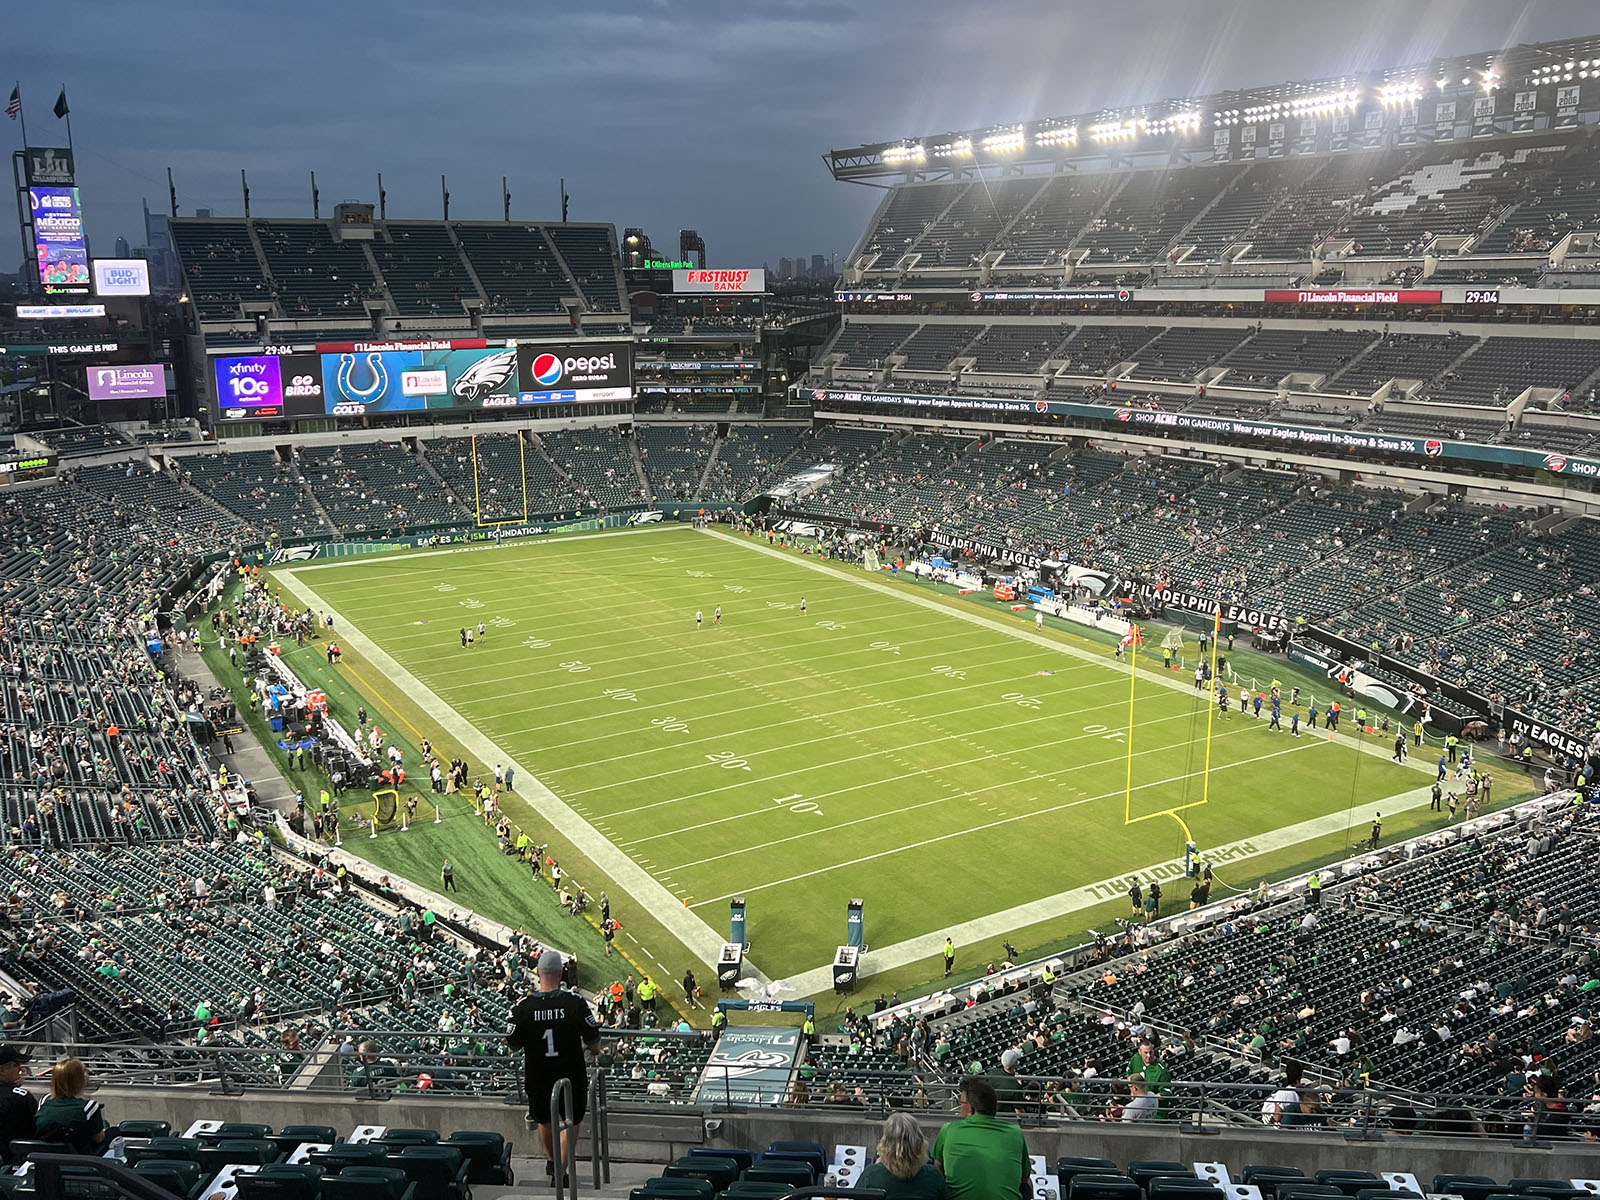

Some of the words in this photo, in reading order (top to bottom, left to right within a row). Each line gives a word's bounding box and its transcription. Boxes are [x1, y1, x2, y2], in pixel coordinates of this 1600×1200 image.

[107, 277, 138, 285] LIGHT
[1307, 292, 1338, 302] Lincoln
[1338, 292, 1375, 302] Financial
[1376, 292, 1398, 302] Field
[1466, 291, 1498, 303] 29:04
[48, 345, 69, 353] THIS
[70, 345, 94, 353] GAME
[94, 344, 102, 352] IS
[264, 345, 293, 355] 29:04
[363, 343, 394, 352] Lincoln
[395, 341, 430, 351] Financial
[431, 340, 451, 350] Field
[229, 362, 267, 376] xfinity
[564, 352, 614, 375] pepsi
[116, 368, 153, 379] Lincoln
[291, 375, 313, 385] GO
[229, 376, 269, 396] 10G
[285, 384, 321, 396] BIRDS
[482, 397, 517, 407] EAGLES
[829, 392, 844, 400] SHOP
[844, 392, 862, 401] ACME
[872, 395, 902, 404] GAMEDAYS
[903, 397, 918, 405] Wear
[932, 399, 950, 407] Eagles
[951, 400, 973, 408] Apparel
[974, 400, 998, 409] In-Store
[1005, 402, 1020, 410] Save
[1020, 403, 1030, 411] 5%
[332, 404, 366, 415] COLTS
[1135, 413, 1155, 423] SHOP
[1154, 414, 1178, 425] ACME
[1178, 417, 1190, 426] ON
[1191, 419, 1231, 431] GAMEDAYS
[1232, 423, 1253, 433] Wear
[1253, 426, 1272, 436] your
[1272, 428, 1298, 439] Eagles
[1298, 430, 1331, 442] Apparel
[1332, 434, 1367, 446] In-Store
[1368, 438, 1377, 447] &
[1377, 439, 1399, 450] Save
[1400, 441, 1415, 452] 5%
[1571, 462, 1597, 475] SHOP
[417, 536, 451, 546] EAGES
[453, 532, 486, 542] AUISM
[1001, 549, 1042, 569] EAGLES
[1228, 606, 1290, 631] EAGLES
[558, 661, 592, 673] 50
[930, 664, 967, 679] 30
[603, 688, 637, 701] 40
[1001, 692, 1043, 708] 20
[650, 716, 688, 732] 30
[1082, 724, 1127, 741] 10
[1512, 719, 1530, 734] FLY
[1530, 724, 1585, 759] EAGLES
[704, 751, 748, 769] 20
[772, 793, 819, 813] 10
[533, 1008, 566, 1021] HURTS
[541, 1028, 559, 1057] 1
[726, 1036, 773, 1045] Lincoln
